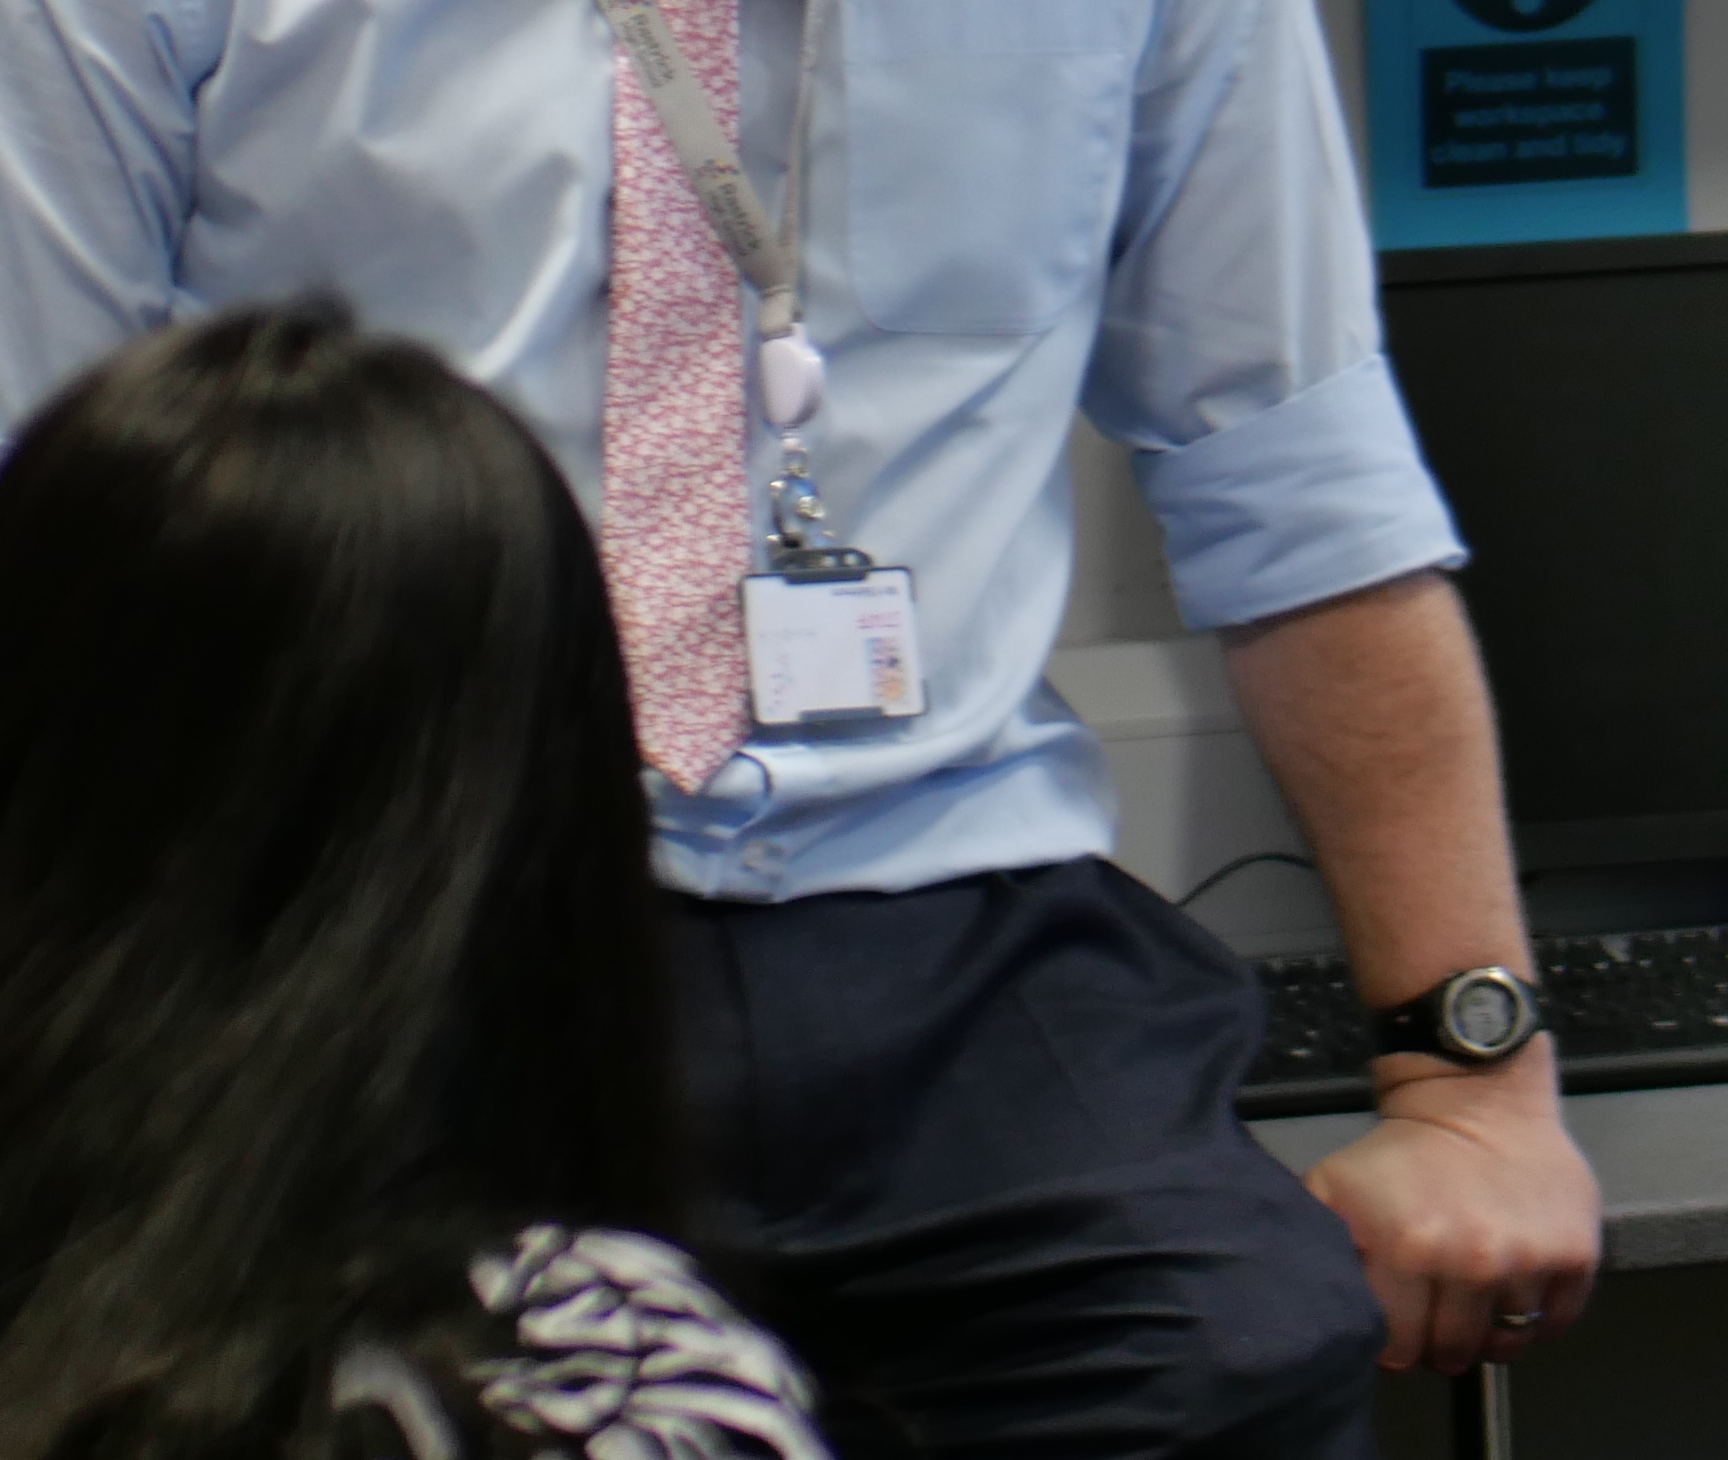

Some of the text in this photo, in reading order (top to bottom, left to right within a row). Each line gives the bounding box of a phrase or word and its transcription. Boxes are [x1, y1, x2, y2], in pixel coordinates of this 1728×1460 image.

[1445, 66, 1614, 94] Please keep
[1454, 103, 1607, 129] workspace
[1432, 133, 1627, 165] clean and tidy
